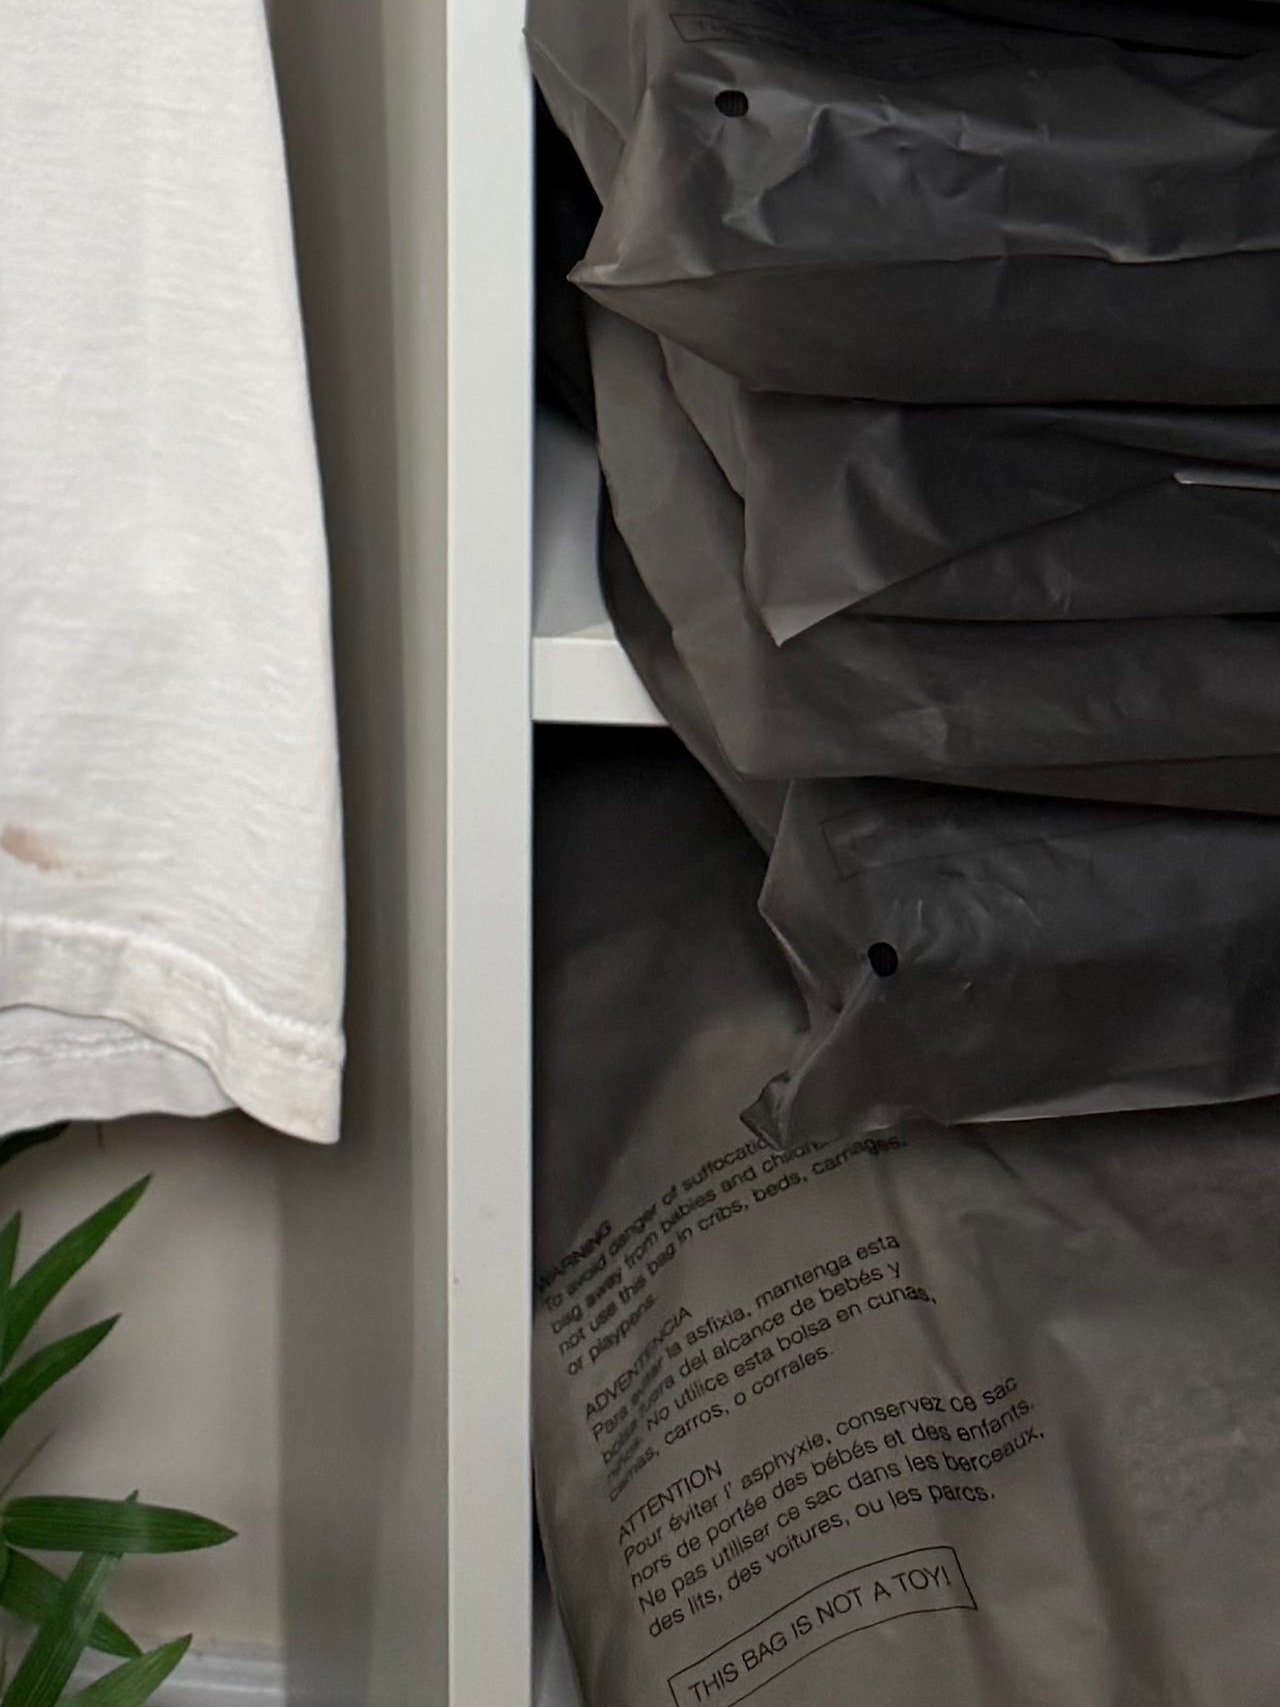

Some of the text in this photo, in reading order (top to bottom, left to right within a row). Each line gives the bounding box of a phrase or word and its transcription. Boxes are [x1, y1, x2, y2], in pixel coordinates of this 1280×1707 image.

[559, 1171, 809, 1355] not use bag in cribs, beds,
[608, 1205, 659, 1257] danger
[661, 1186, 680, 1207] of
[624, 1231, 659, 1269] from
[659, 1189, 717, 1233] babies
[721, 1167, 758, 1194] and
[646, 1283, 939, 1433] No utilice esta bolsa en cunas,
[666, 1341, 683, 1360] la
[685, 1306, 753, 1348] asfixia,
[754, 1254, 853, 1310] mantenga
[855, 1234, 902, 1262] esta
[678, 1259, 903, 1379] del alcance de bebés y
[567, 1355, 584, 1376] or
[663, 1343, 835, 1446] carros, o corrales.
[618, 1458, 724, 1546] ATTENTION
[623, 1525, 663, 1567] Pour
[668, 1493, 720, 1533] éviter
[740, 1432, 833, 1491] asphyxie,
[835, 1394, 947, 1437] conservez
[949, 1394, 978, 1413] ce
[981, 1375, 1019, 1406] sac
[630, 1398, 1036, 1590] hors de portée des bébés et des enfants.
[637, 1426, 1046, 1614] Ne pas utiliser ce sac dans les berceaux,
[648, 1483, 997, 1639] des lits, des voitures, ou les parcs.
[687, 1564, 953, 1703] THIS BAG IS NOT A TOY!
